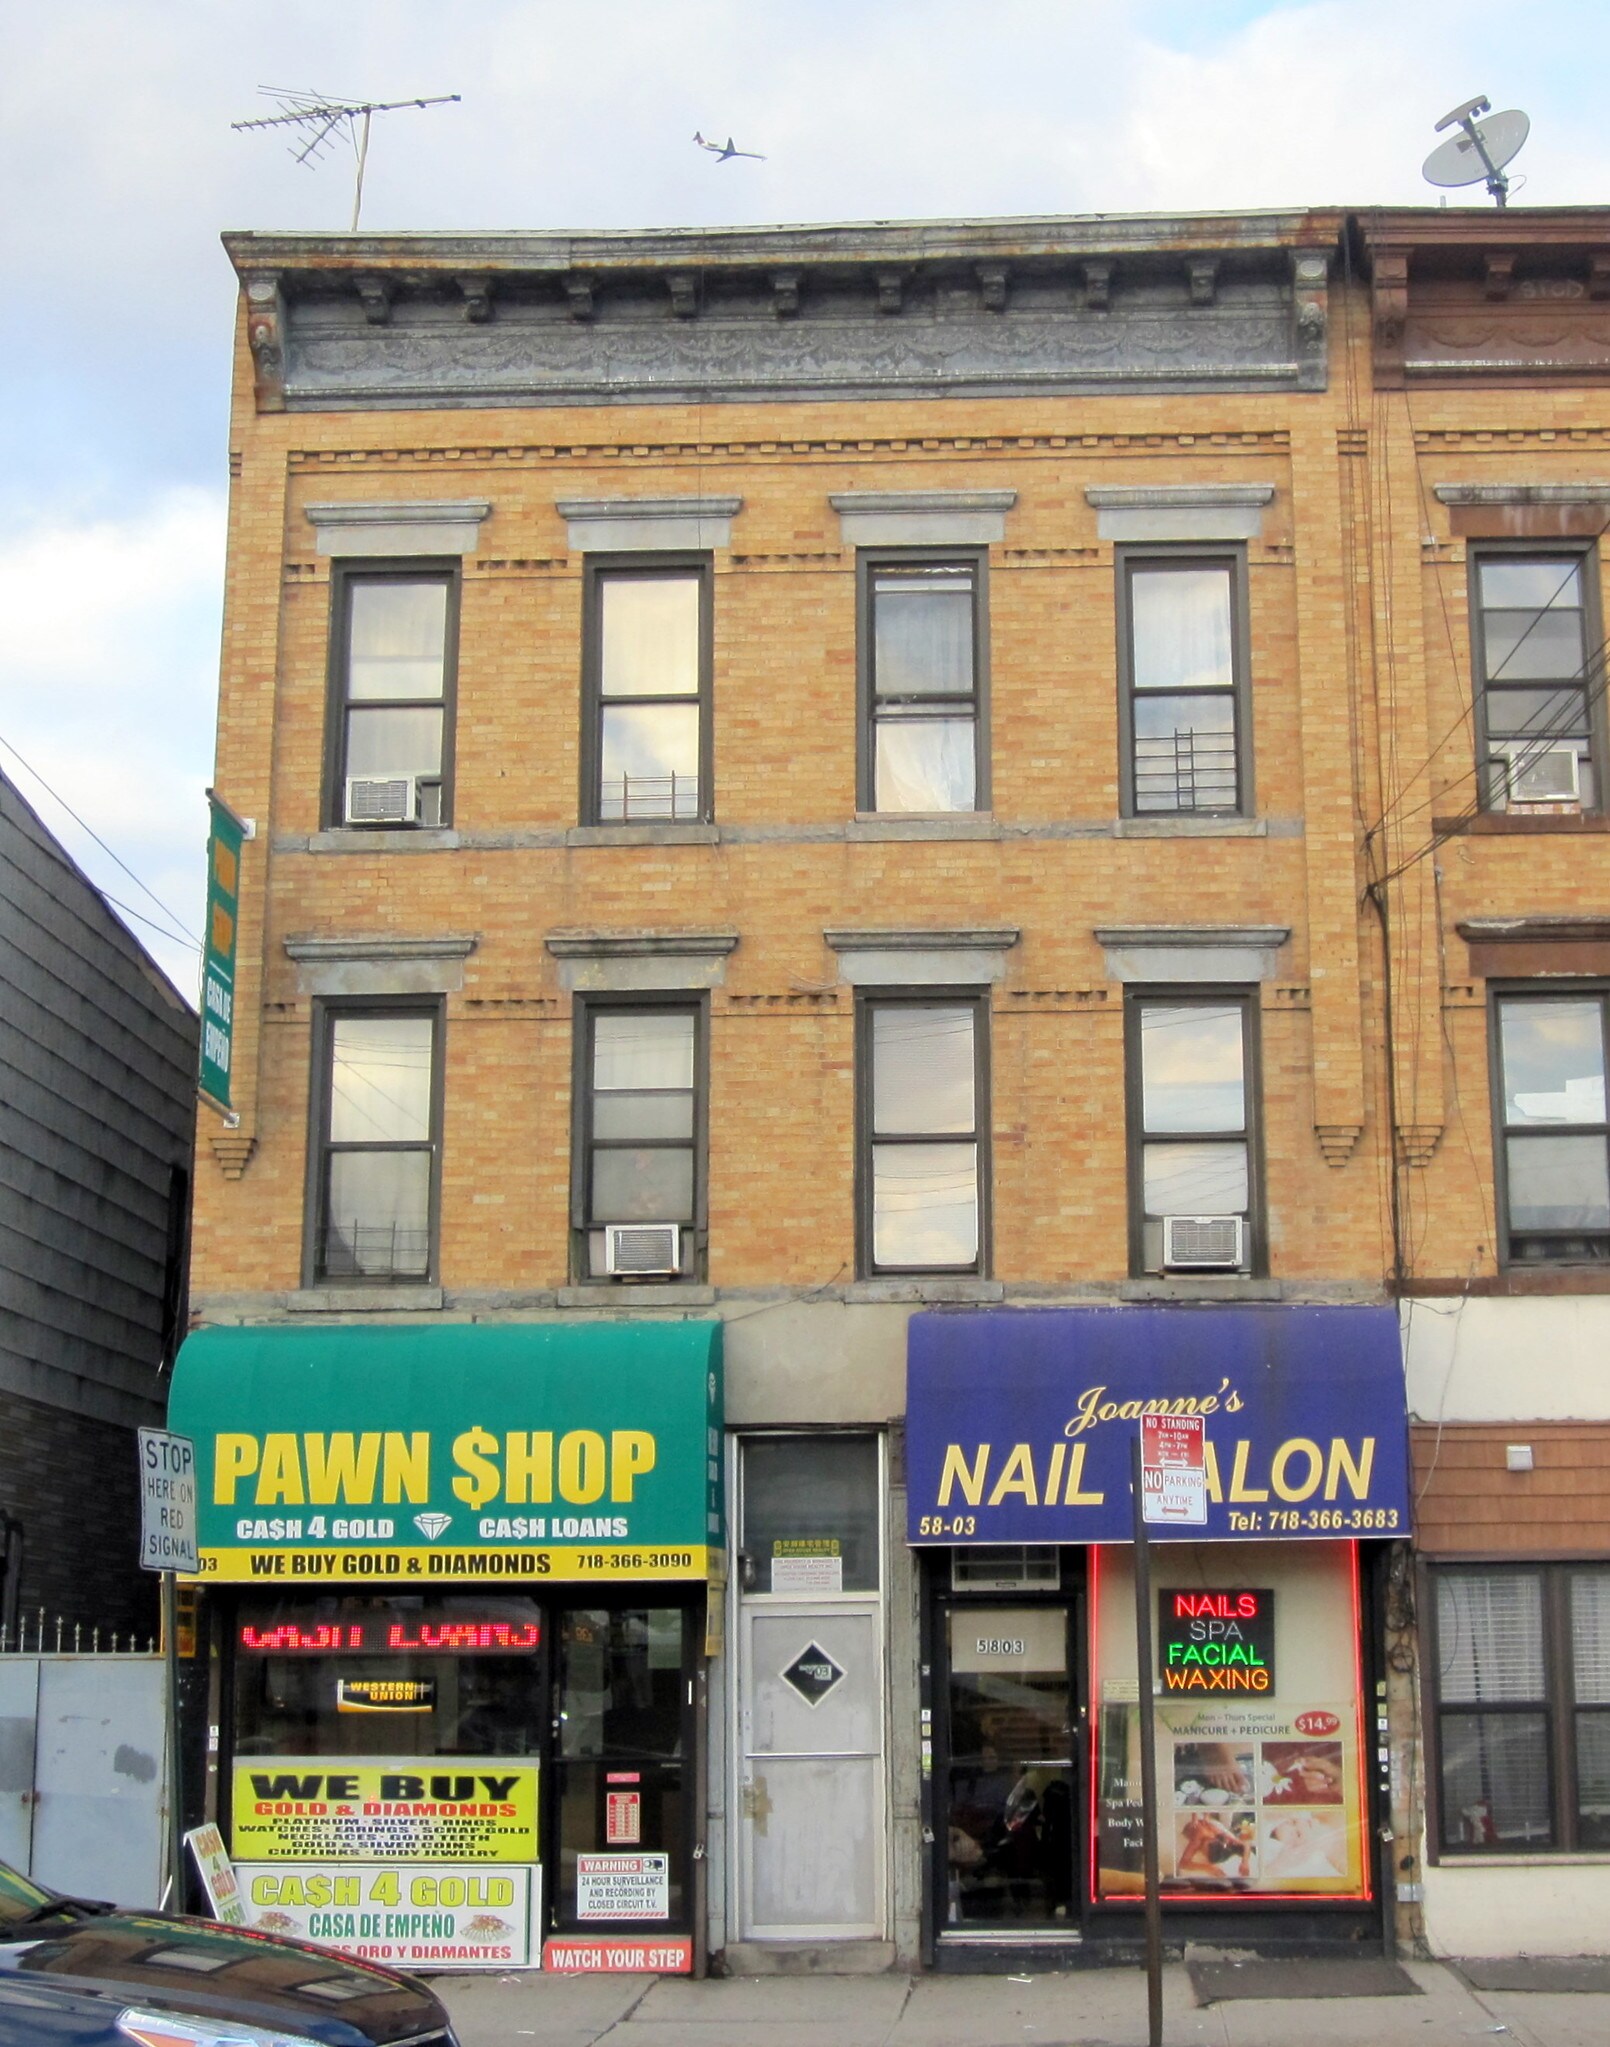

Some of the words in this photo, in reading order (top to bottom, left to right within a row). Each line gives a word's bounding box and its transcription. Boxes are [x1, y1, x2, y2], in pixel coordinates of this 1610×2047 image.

[1064, 1377, 1244, 1437] Joanne's
[1145, 1417, 1158, 1429] NO
[1161, 1417, 1200, 1431] STANDING
[146, 1440, 191, 1475] STOP
[213, 1431, 430, 1505] PAWN
[451, 1425, 656, 1510] $HOP
[937, 1443, 1104, 1506] NAIL
[1190, 1437, 1375, 1503] LON
[1145, 1470, 1162, 1489] NO
[1164, 1475, 1202, 1488] PARKING
[148, 1477, 176, 1501] HERE
[180, 1483, 193, 1504] ON
[1157, 1495, 1192, 1505] ANYTIME
[160, 1507, 184, 1529] RED
[919, 1516, 976, 1535] 58-03
[1228, 1511, 1262, 1531] Tel:
[1269, 1509, 1399, 1530] 718-366-3683
[236, 1518, 301, 1540] CA$H
[307, 1516, 327, 1539] 4
[332, 1518, 394, 1539] GOLD
[479, 1516, 545, 1539] CA$H
[551, 1517, 628, 1538] LOANS
[149, 1535, 194, 1560] SIGNAL
[250, 1554, 285, 1574] WE
[291, 1554, 336, 1574] BUY
[342, 1554, 400, 1574] GOLD
[406, 1556, 422, 1574] &
[428, 1553, 551, 1574] DIAMONDS
[577, 1553, 691, 1568] 718-366-3090
[1175, 1594, 1257, 1618] NAILS
[1189, 1621, 1243, 1641] SPA
[979, 1640, 1022, 1653] 5803
[1168, 1643, 1264, 1666] FACIAL
[350, 1682, 414, 1691] WESTERN
[1165, 1668, 1269, 1690] WAXING
[370, 1691, 414, 1700] UNION
[1249, 1713, 1276, 1723] Special
[1173, 1726, 1228, 1735] MANICURE
[1240, 1725, 1291, 1735] PEDICURE
[250, 1775, 360, 1800] WE
[380, 1775, 521, 1801] BUY
[254, 1802, 328, 1816] GOLD
[335, 1804, 355, 1816] &
[363, 1802, 517, 1817] DIAMONDS
[1106, 1799, 1123, 1809] Spa
[238, 1825, 322, 1833] WATCHES
[335, 1825, 410, 1833] EARINGS
[422, 1826, 482, 1834] SCRAP
[485, 1826, 530, 1834] GOLD
[272, 1818, 360, 1826] PLATINUM
[372, 1818, 430, 1826] SILVER
[1108, 1818, 1133, 1830] Body
[278, 1833, 377, 1841] NECKLACES
[440, 1834, 490, 1842] TEETH
[358, 1841, 418, 1849] SILVER
[421, 1841, 475, 1849] COINS
[1123, 1838, 1143, 1848] Faci
[268, 1848, 360, 1856] CUFFLINKS
[369, 1849, 419, 1857] BODY
[422, 1849, 499, 1857] JEWELRY
[584, 1860, 638, 1872] WARNING
[581, 1877, 590, 1886] 24
[591, 1877, 611, 1886] HOUR
[612, 1876, 663, 1885] SURVEILLANCE
[251, 1873, 360, 1908] CA$H
[369, 1871, 401, 1907] 4
[410, 1876, 515, 1907] GOLD
[589, 1888, 603, 1897] AND
[605, 1888, 645, 1897] RECORDING
[647, 1888, 655, 1897] BY
[588, 1900, 615, 1909] CLOSED
[616, 1900, 643, 1909] CIRCUIT
[645, 1900, 657, 1909] T.V.
[309, 1913, 353, 1938] CASA
[360, 1914, 381, 1938] DE
[385, 1910, 455, 1938] EMPEÑO
[357, 1945, 392, 1959] ORO
[397, 1945, 407, 1959] Y
[411, 1946, 511, 1959] DIAMANTES
[551, 1949, 601, 1968] WATCH
[606, 1949, 645, 1968] YOUR
[649, 1949, 685, 1967] STEP
